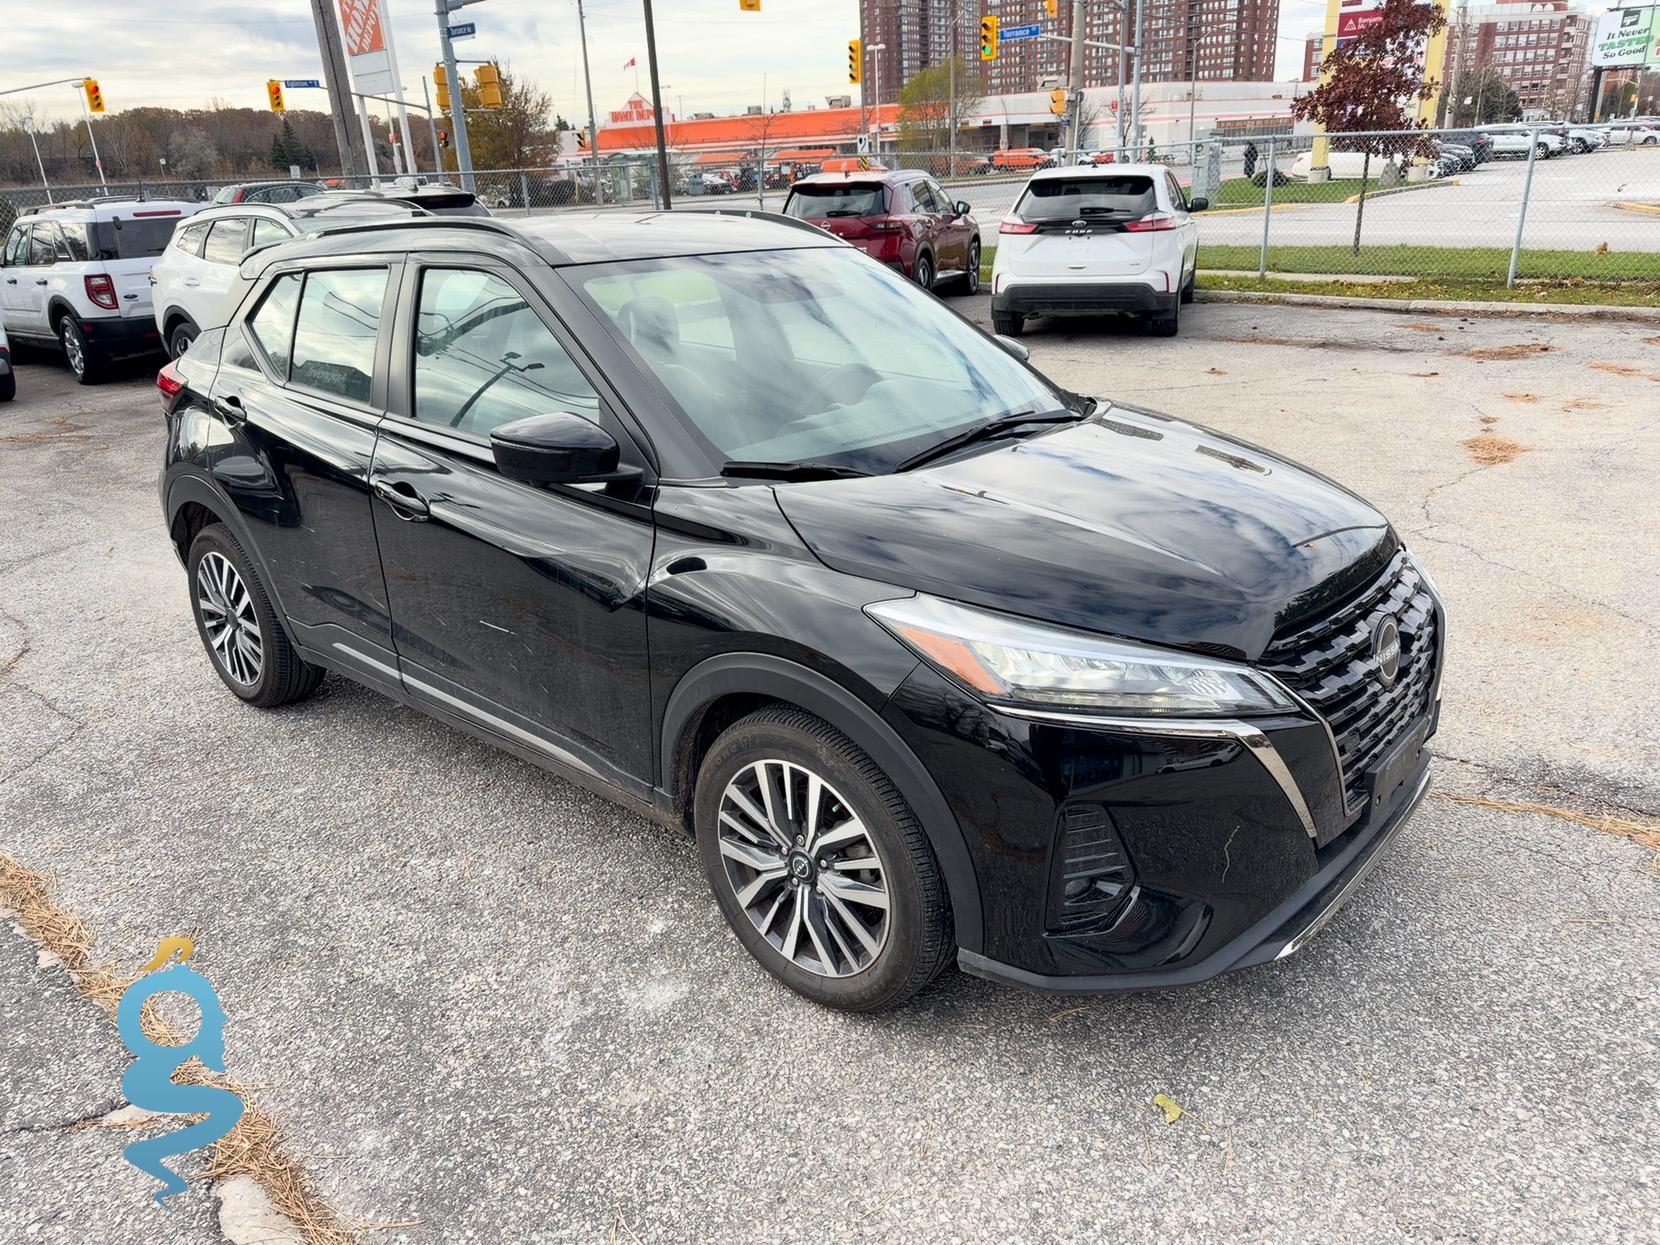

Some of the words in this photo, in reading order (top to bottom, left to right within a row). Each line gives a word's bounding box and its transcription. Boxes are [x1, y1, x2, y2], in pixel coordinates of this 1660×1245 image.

[1003, 29, 1030, 38] Torrance
[1617, 28, 1650, 38] Never
[1602, 52, 1616, 60] So
[1618, 45, 1647, 57] Good
[628, 100, 642, 109] THE
[610, 111, 633, 122] HOME
